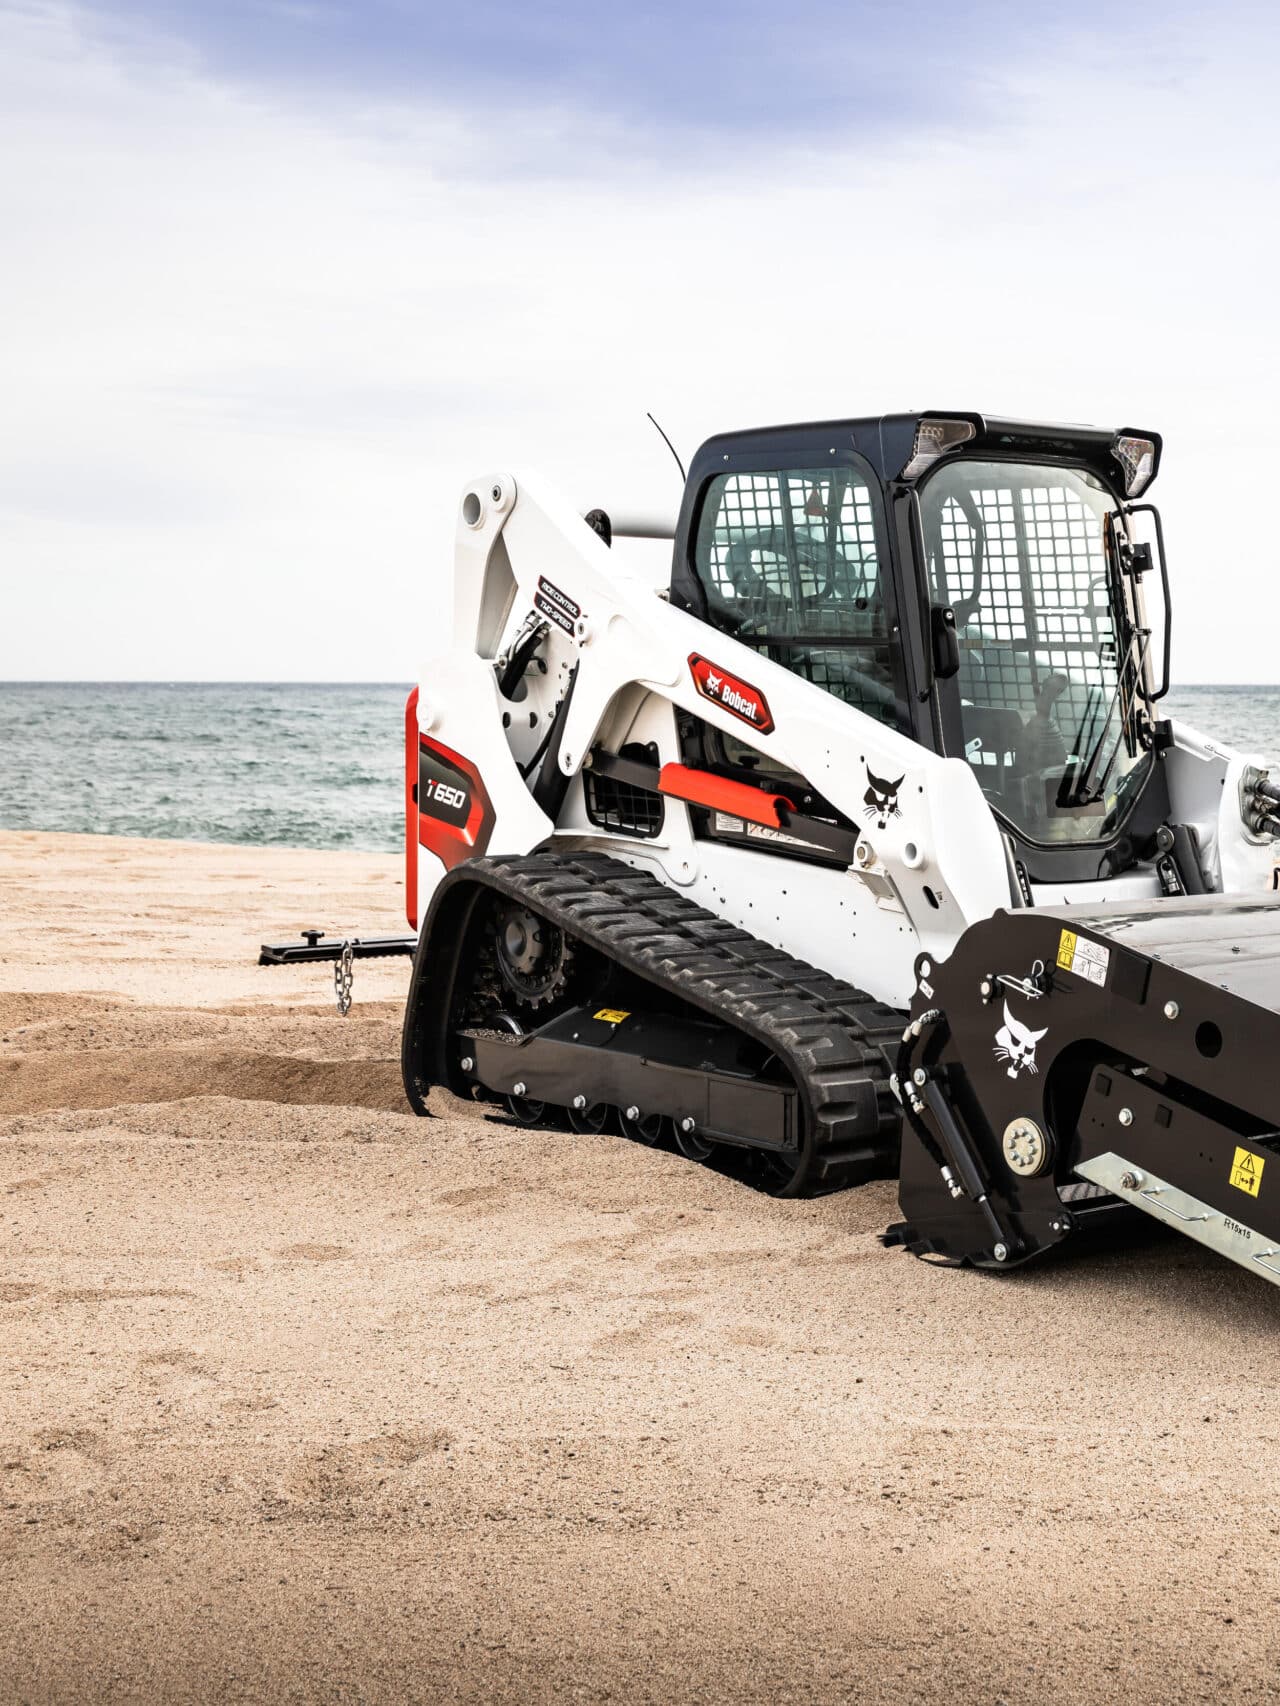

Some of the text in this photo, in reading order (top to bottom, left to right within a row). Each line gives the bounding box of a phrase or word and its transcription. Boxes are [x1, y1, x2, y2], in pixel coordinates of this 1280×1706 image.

[540, 600, 572, 630] TWO-SPEED
[553, 591, 578, 616] CONTROL
[722, 684, 757, 720] Bobcat
[427, 779, 467, 809] T650
[1224, 1218, 1251, 1239] R15x15
